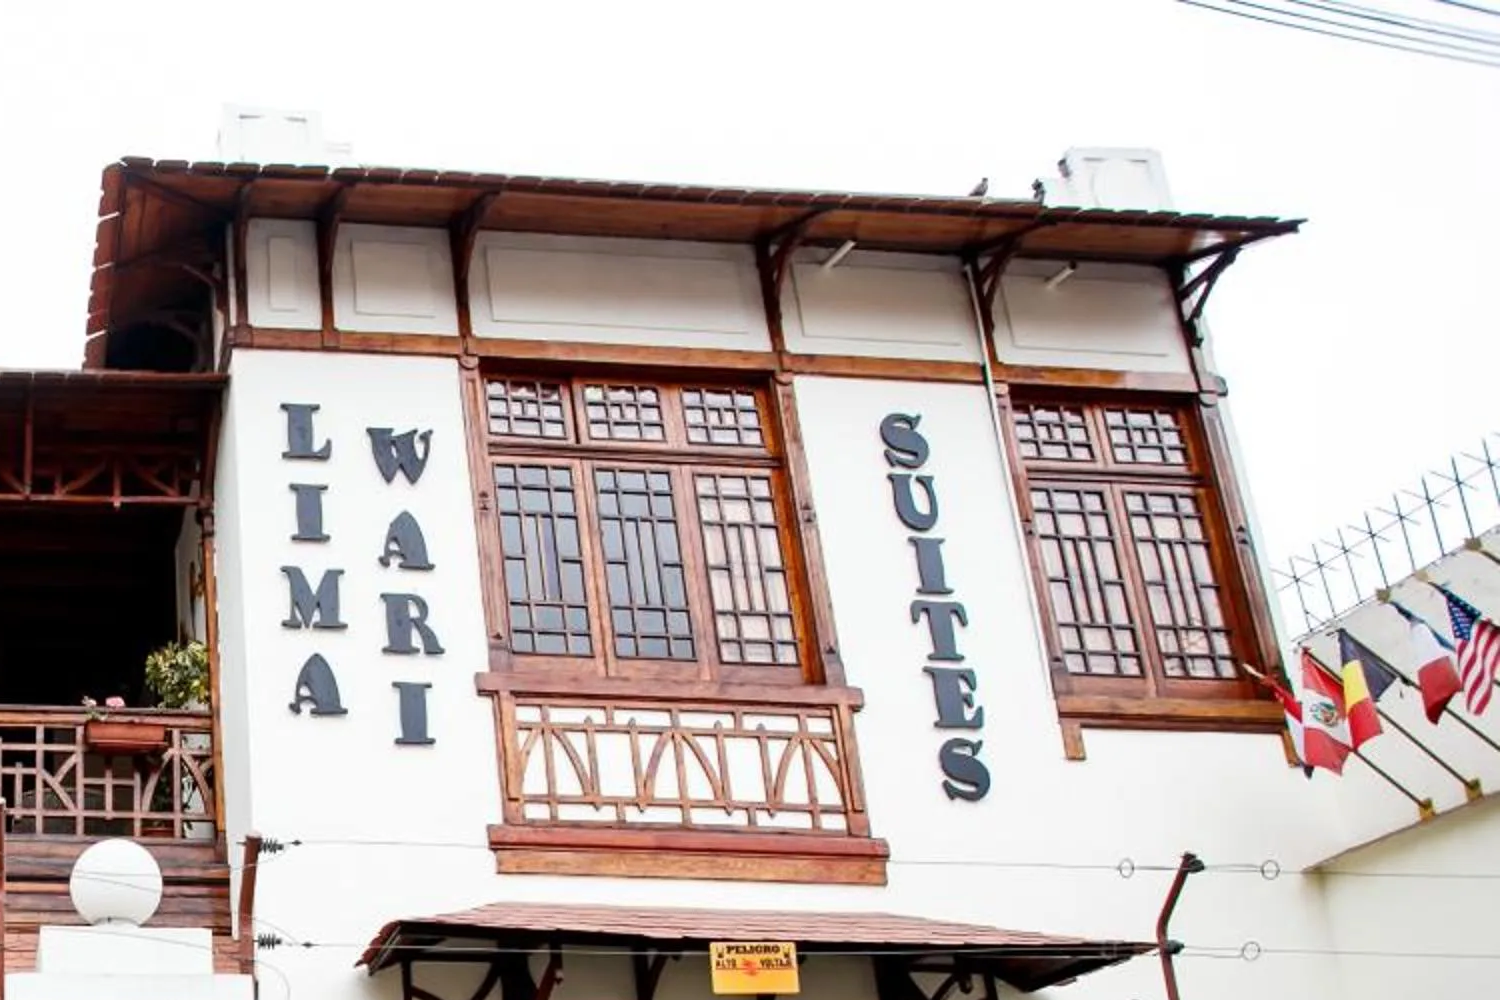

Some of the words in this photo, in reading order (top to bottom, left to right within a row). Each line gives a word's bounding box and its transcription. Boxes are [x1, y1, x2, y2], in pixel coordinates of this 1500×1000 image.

[280, 403, 349, 717] LIMA
[365, 427, 445, 746] WARI
[879, 413, 991, 803] SUITES
[725, 945, 781, 955] PELIGRO
